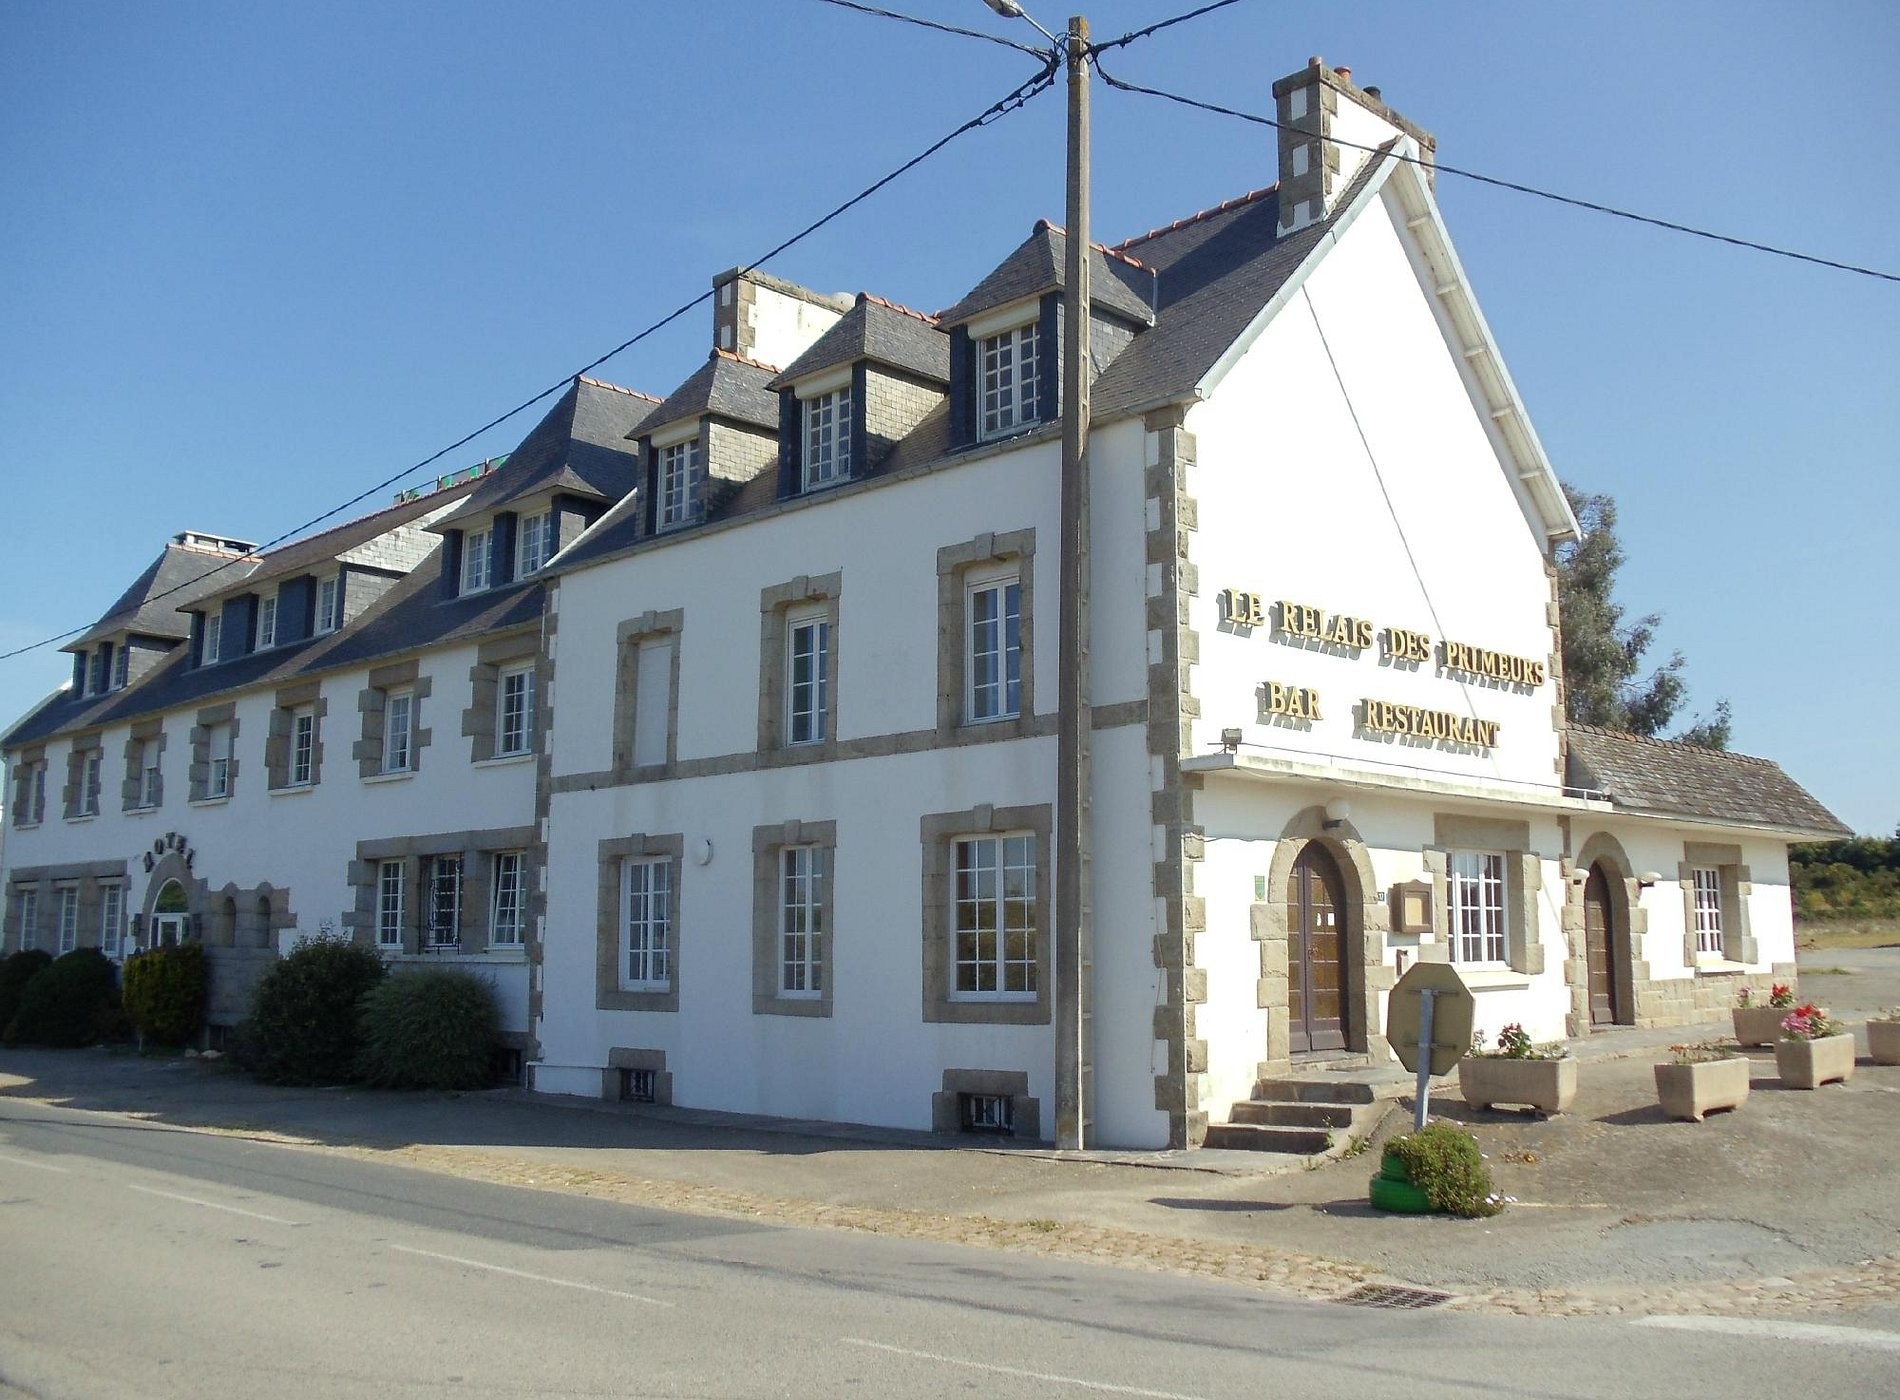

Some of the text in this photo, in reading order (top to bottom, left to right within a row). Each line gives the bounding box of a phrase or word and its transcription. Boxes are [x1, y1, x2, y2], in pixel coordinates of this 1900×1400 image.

[1223, 588, 1545, 687] LE RELAIS DES PRIMEURS
[1264, 680, 1501, 748] BAR RESTAURANT
